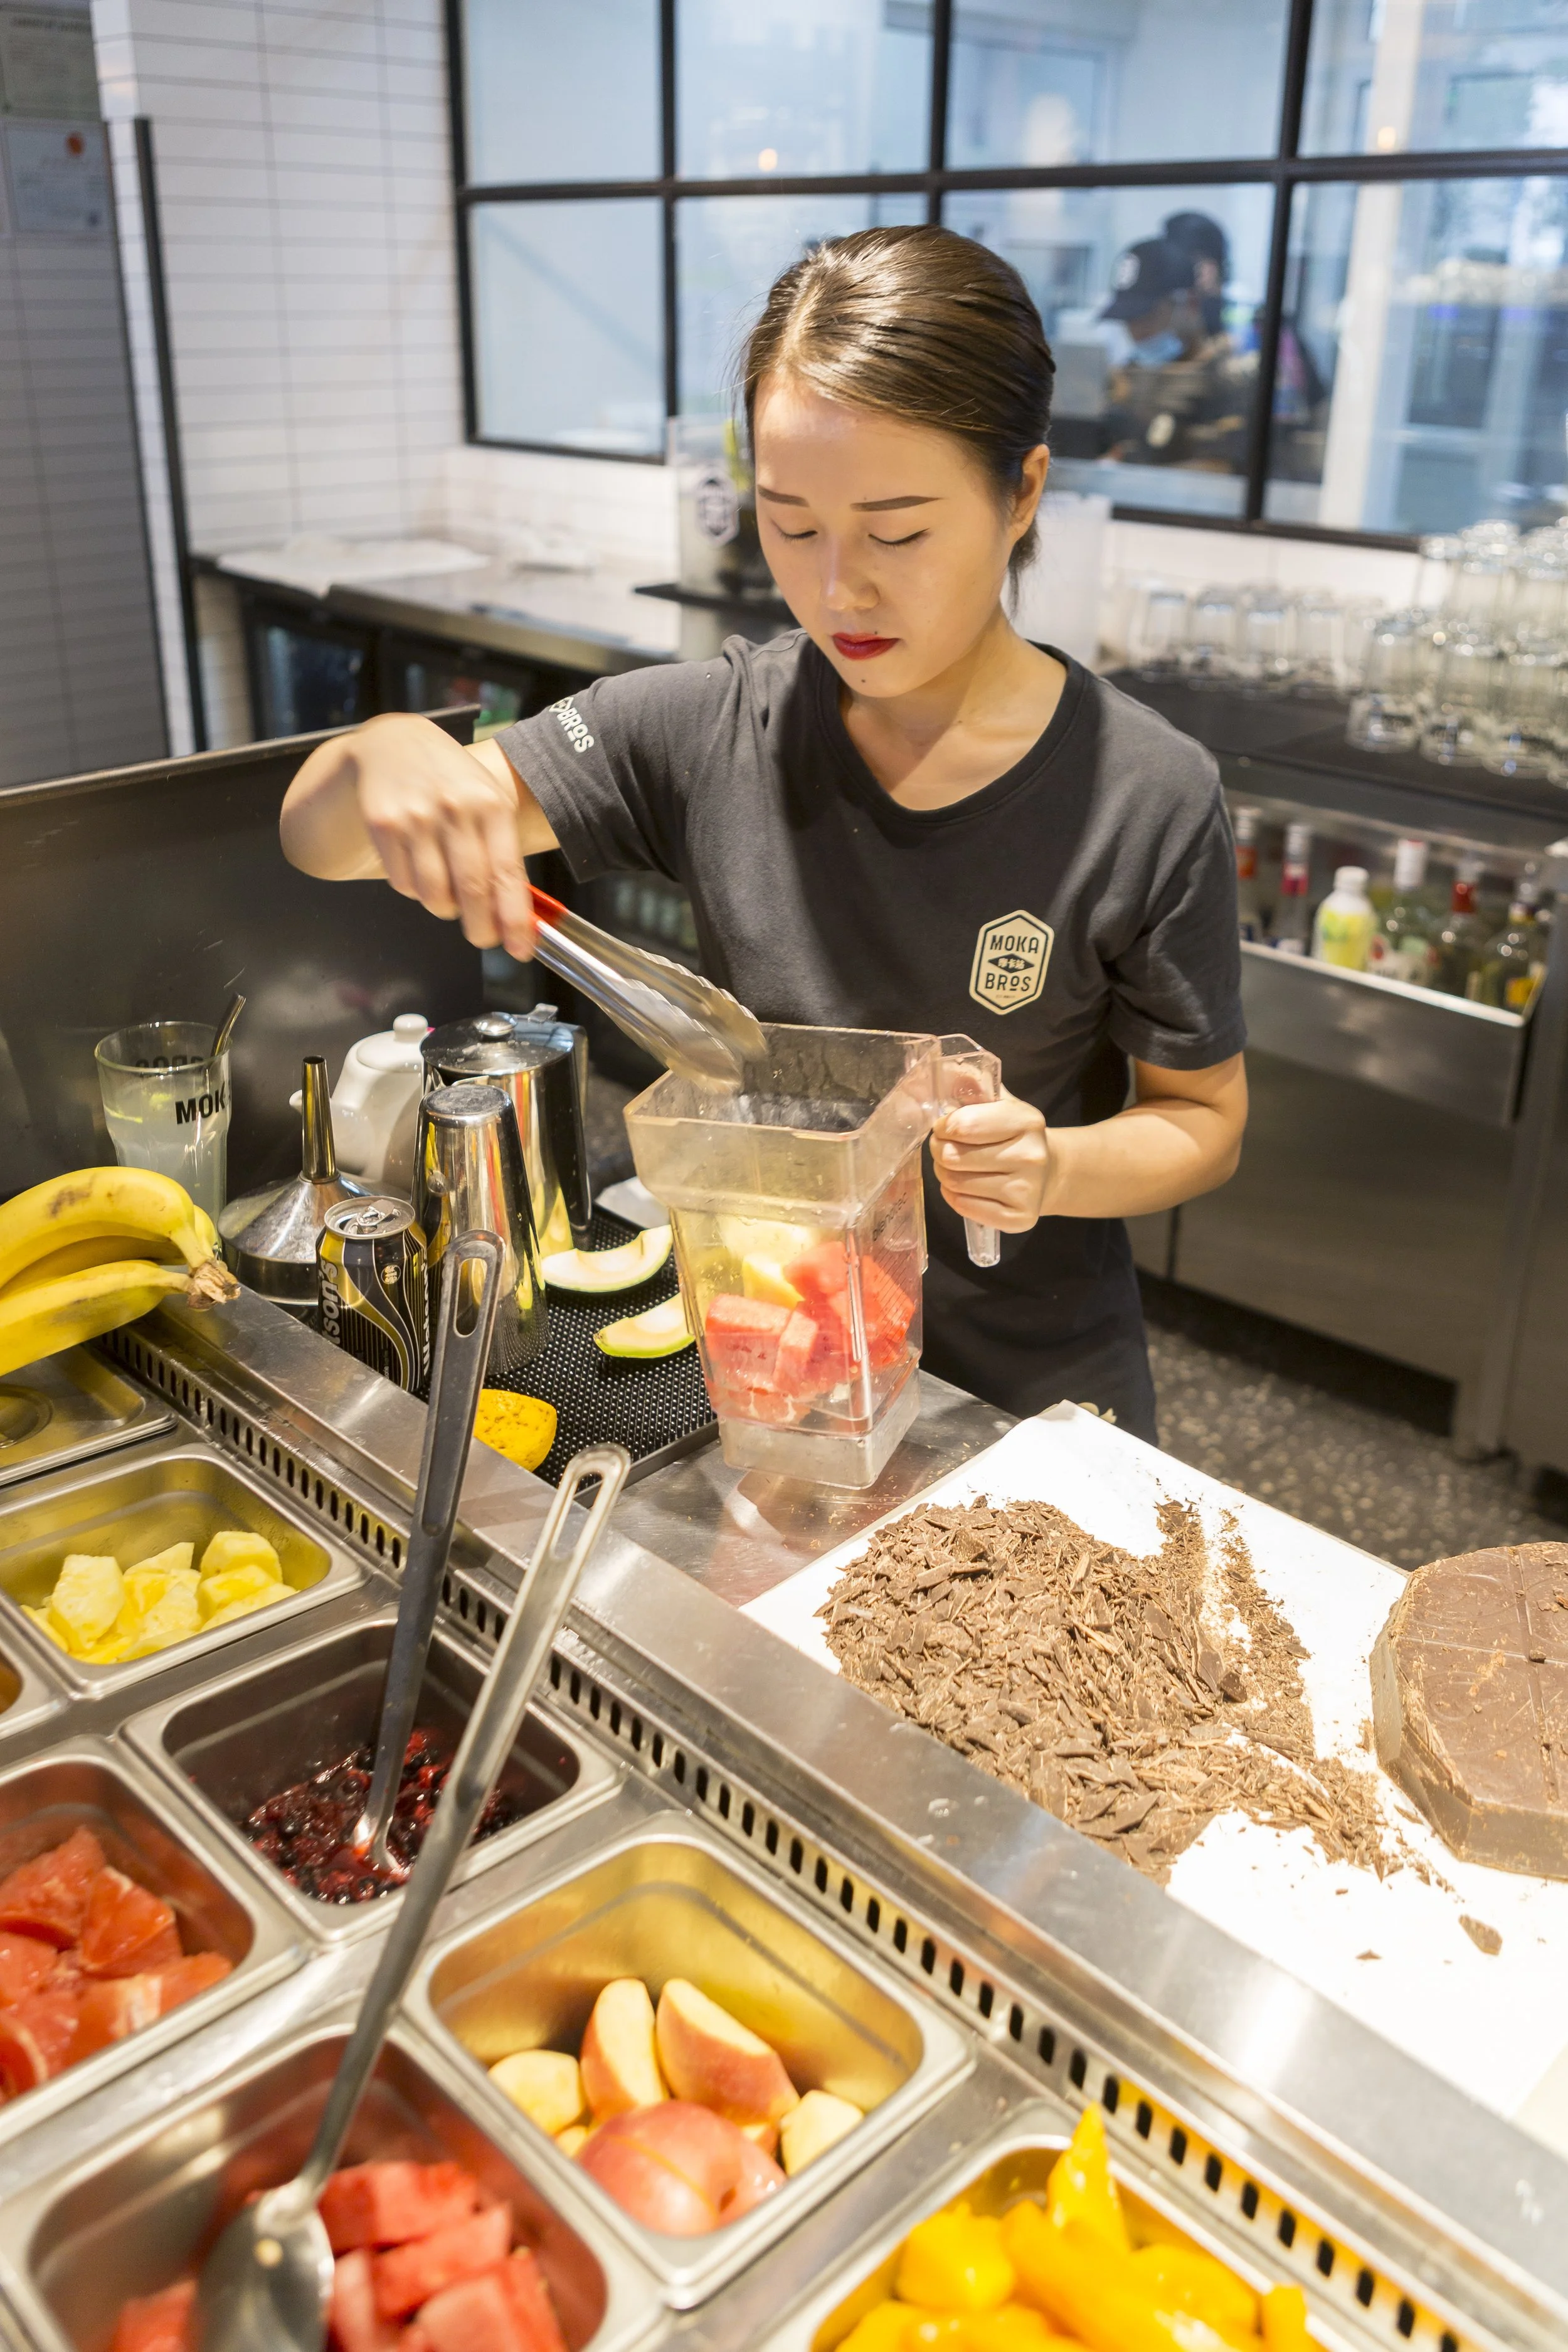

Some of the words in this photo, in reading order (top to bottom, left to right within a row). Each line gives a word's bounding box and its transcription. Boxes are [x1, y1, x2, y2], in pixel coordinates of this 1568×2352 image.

[556, 707, 595, 753] BROS
[990, 935, 1039, 953] MOKA
[175, 1079, 231, 1125] MOK
[319, 1260, 340, 1344] tson's
